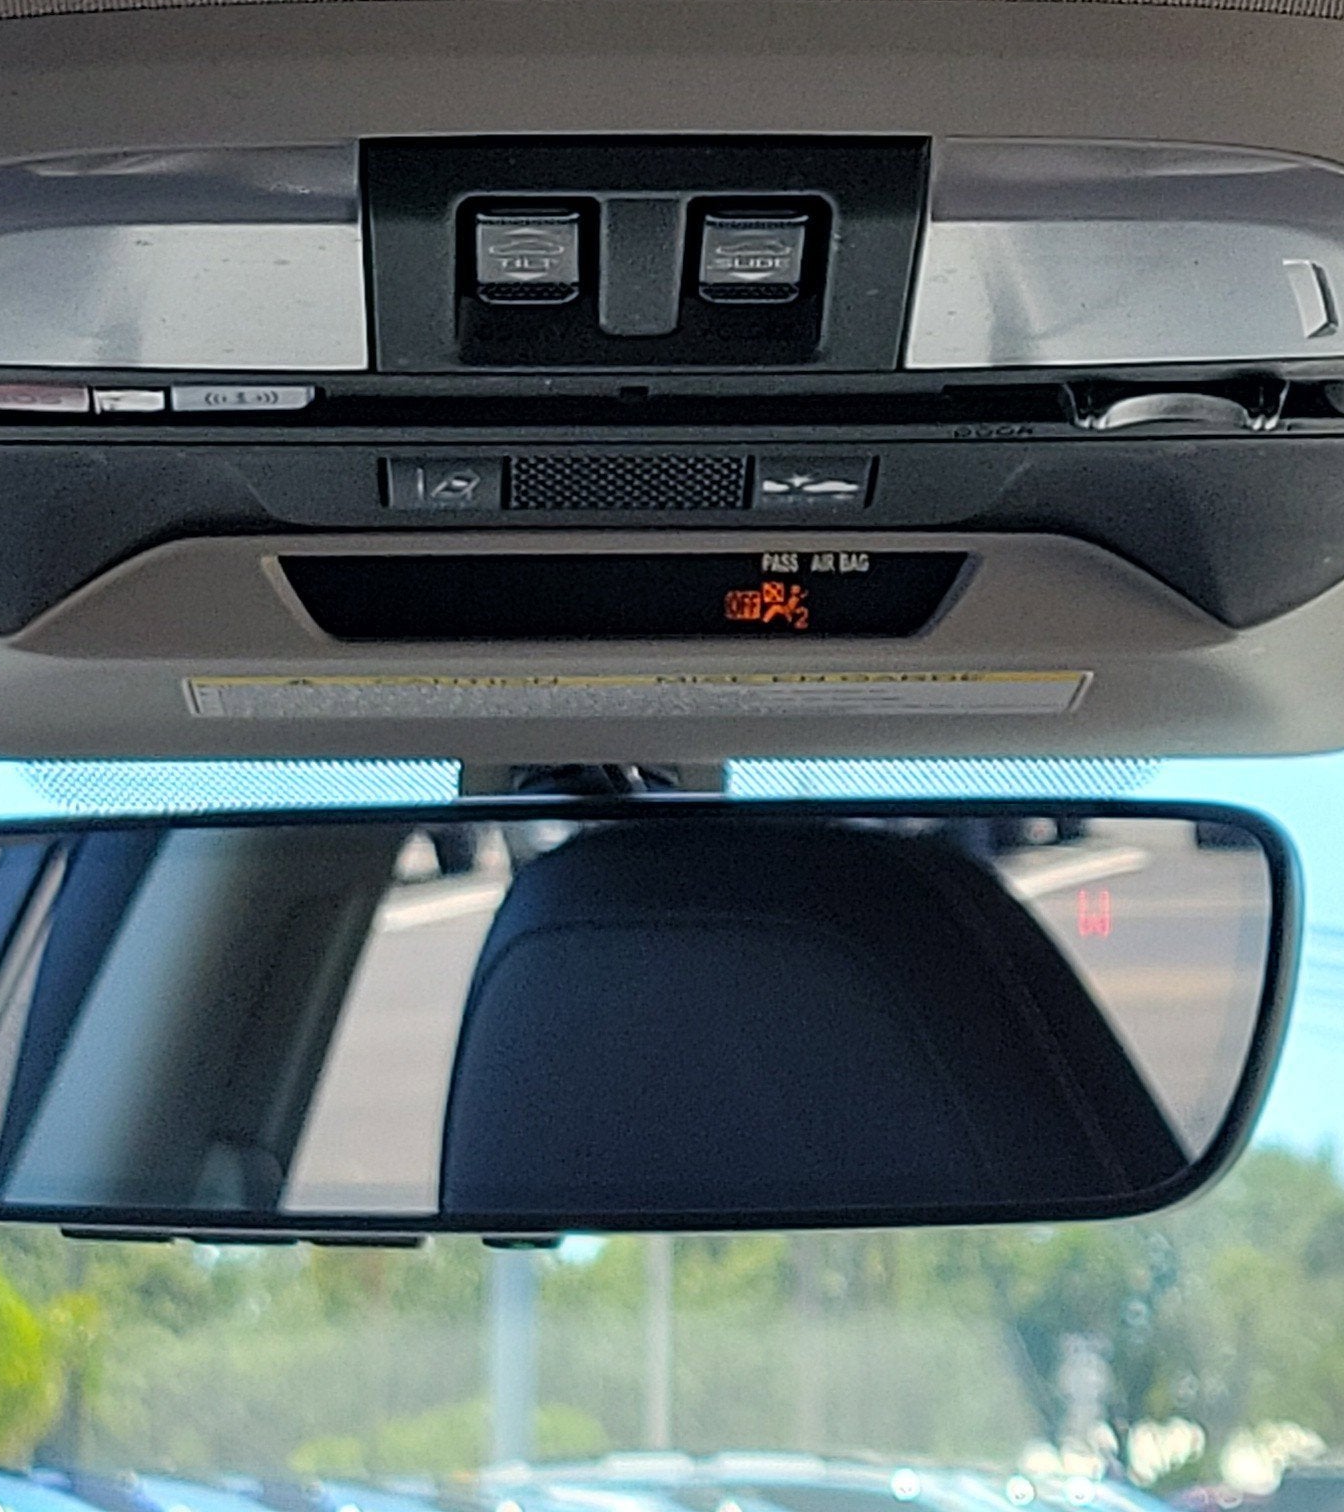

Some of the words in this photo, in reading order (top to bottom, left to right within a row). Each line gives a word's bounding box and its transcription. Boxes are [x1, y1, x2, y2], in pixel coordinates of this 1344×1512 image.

[762, 553, 798, 572] PASS
[811, 553, 835, 573] AIR
[839, 553, 869, 573] BAG
